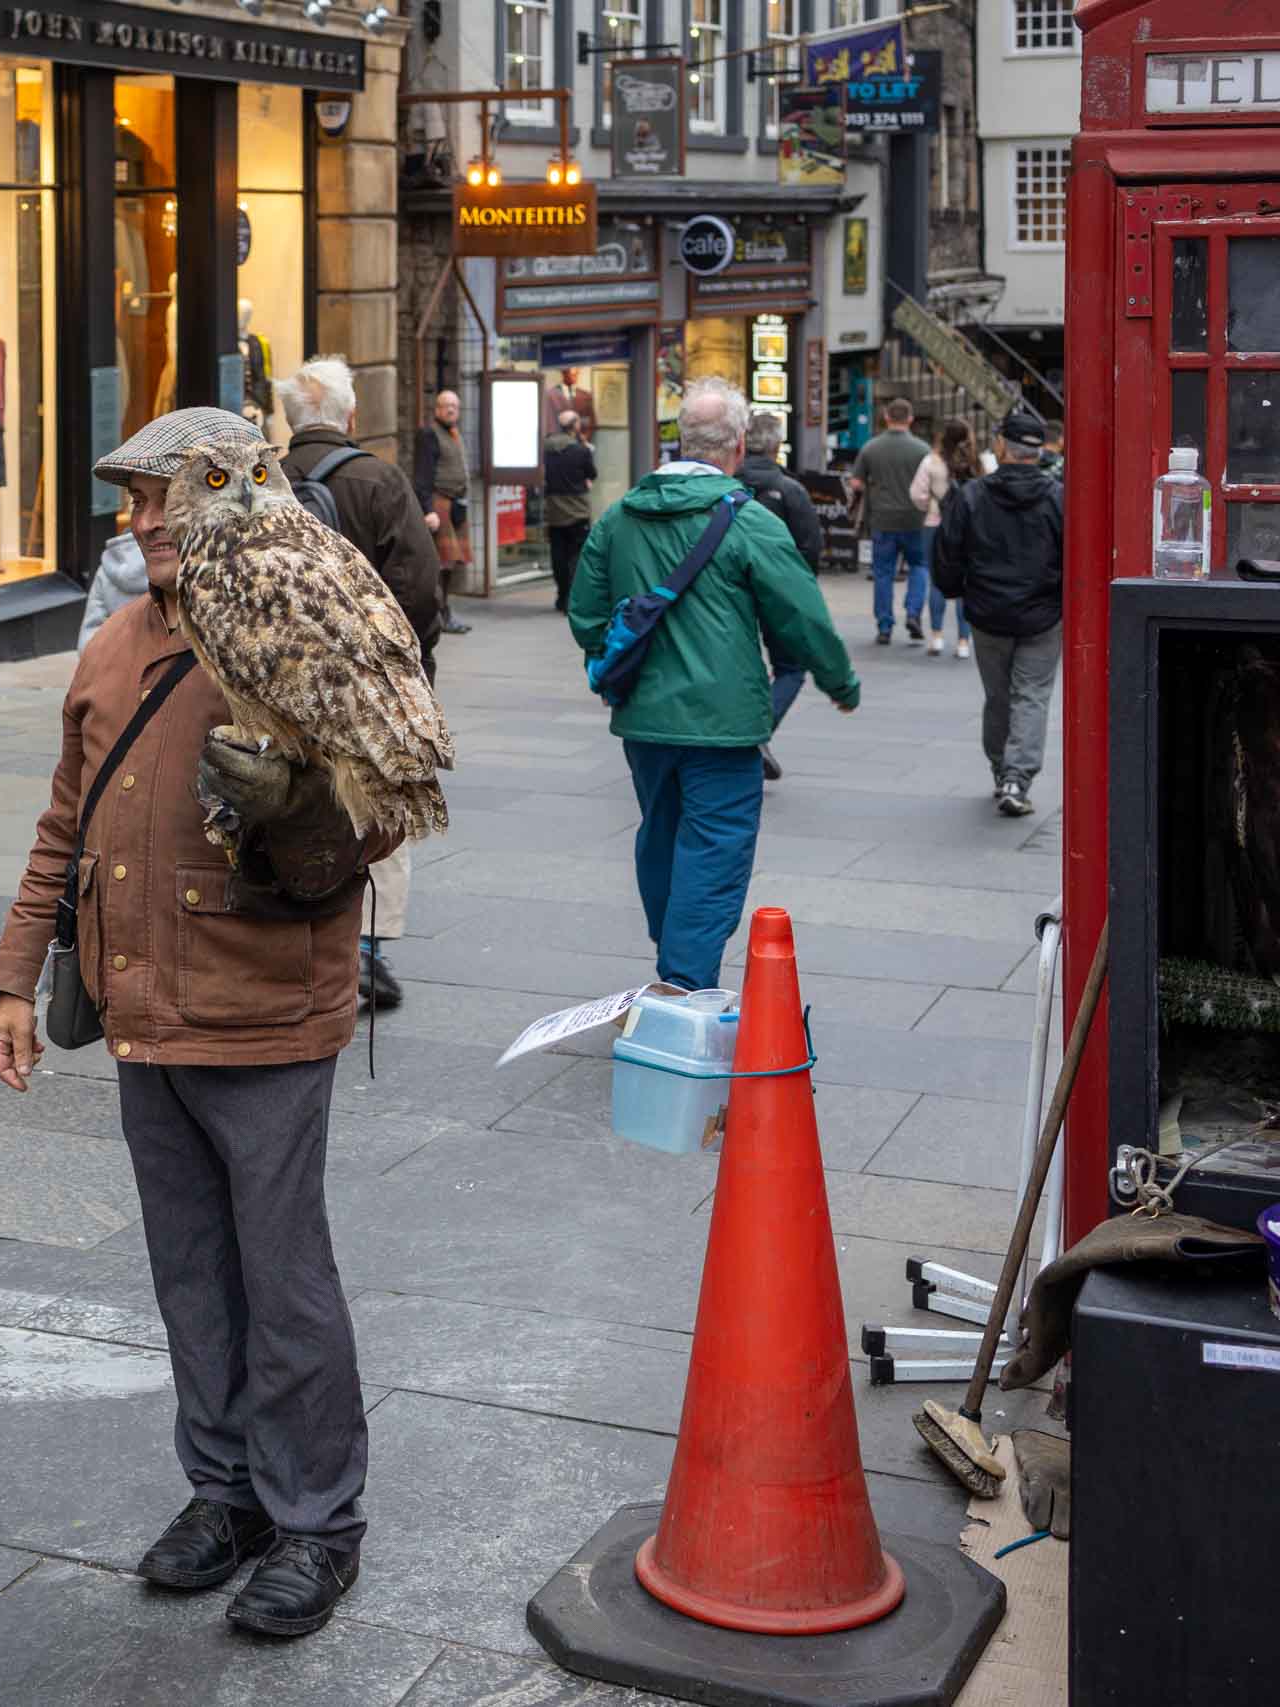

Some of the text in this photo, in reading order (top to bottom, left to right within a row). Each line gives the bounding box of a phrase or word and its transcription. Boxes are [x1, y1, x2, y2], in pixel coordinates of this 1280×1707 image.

[10, 7, 357, 75] JOHN MORRISON KILTMAKERS
[847, 82, 920, 98] TO LET
[459, 203, 587, 225] MONTEITHS
